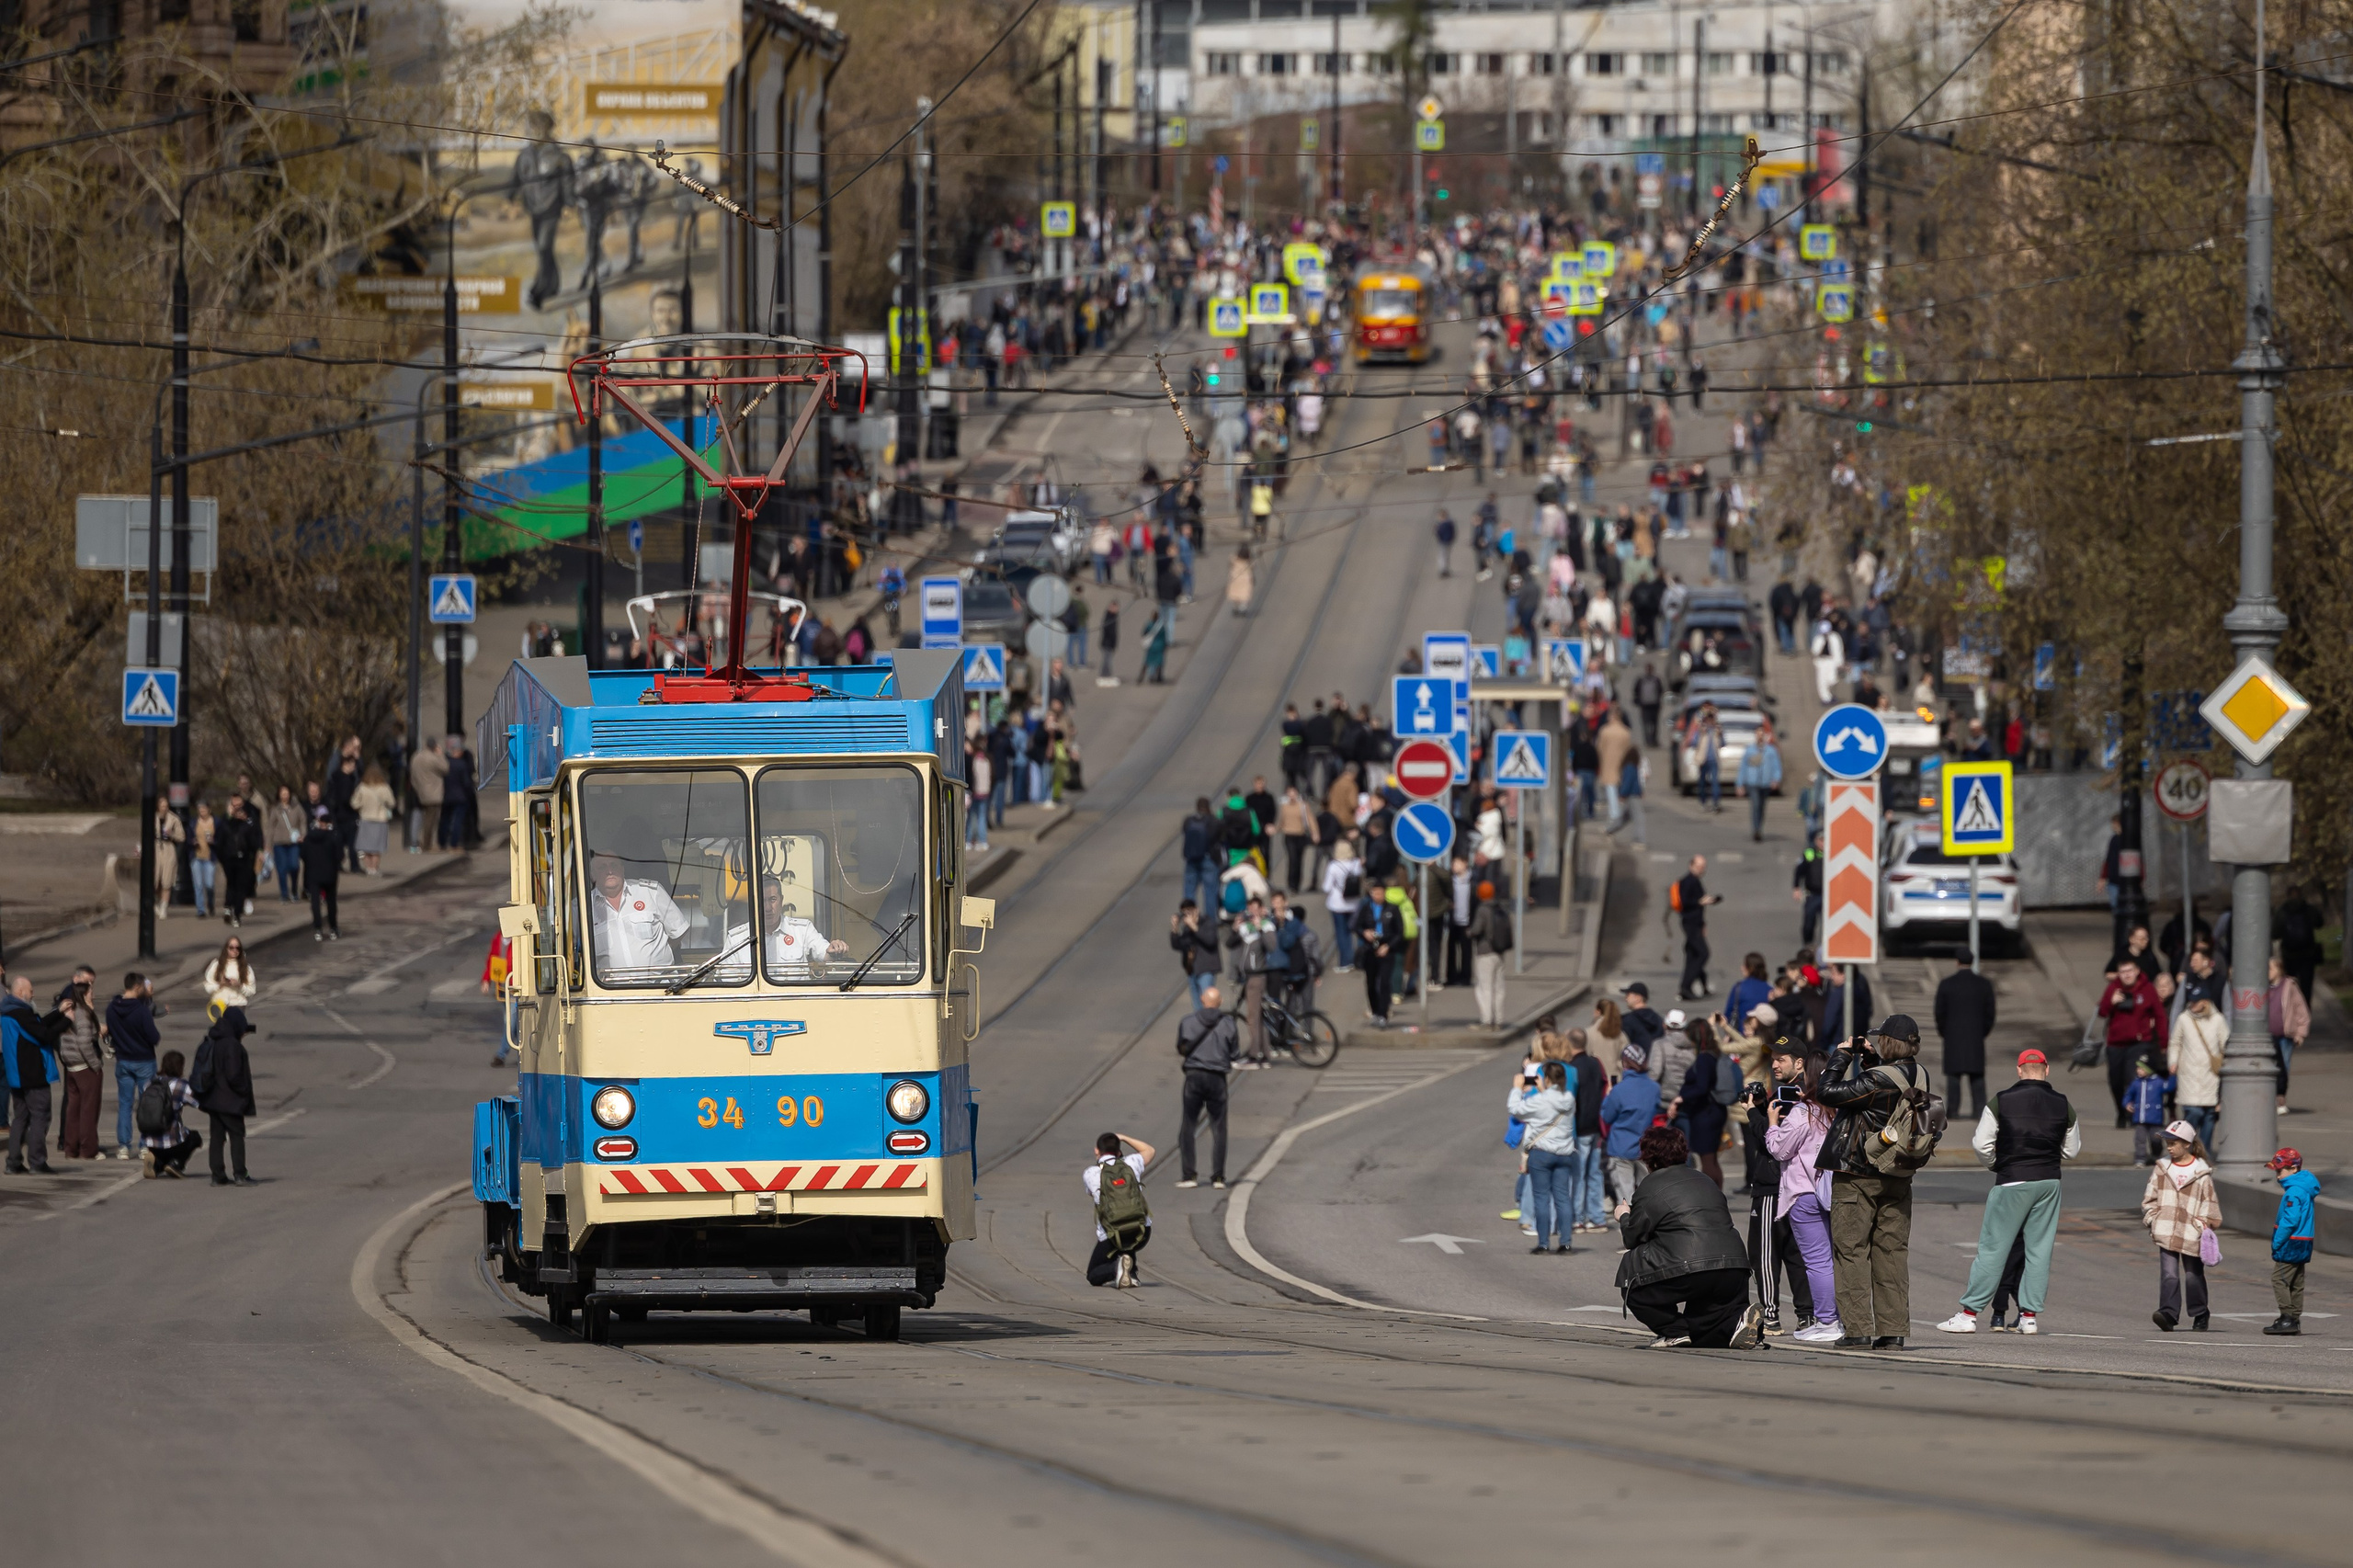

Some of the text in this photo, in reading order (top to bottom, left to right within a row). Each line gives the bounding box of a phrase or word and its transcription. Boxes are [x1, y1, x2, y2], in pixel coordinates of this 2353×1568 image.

[2168, 777, 2202, 801] 40
[698, 1096, 824, 1129] 34 90
